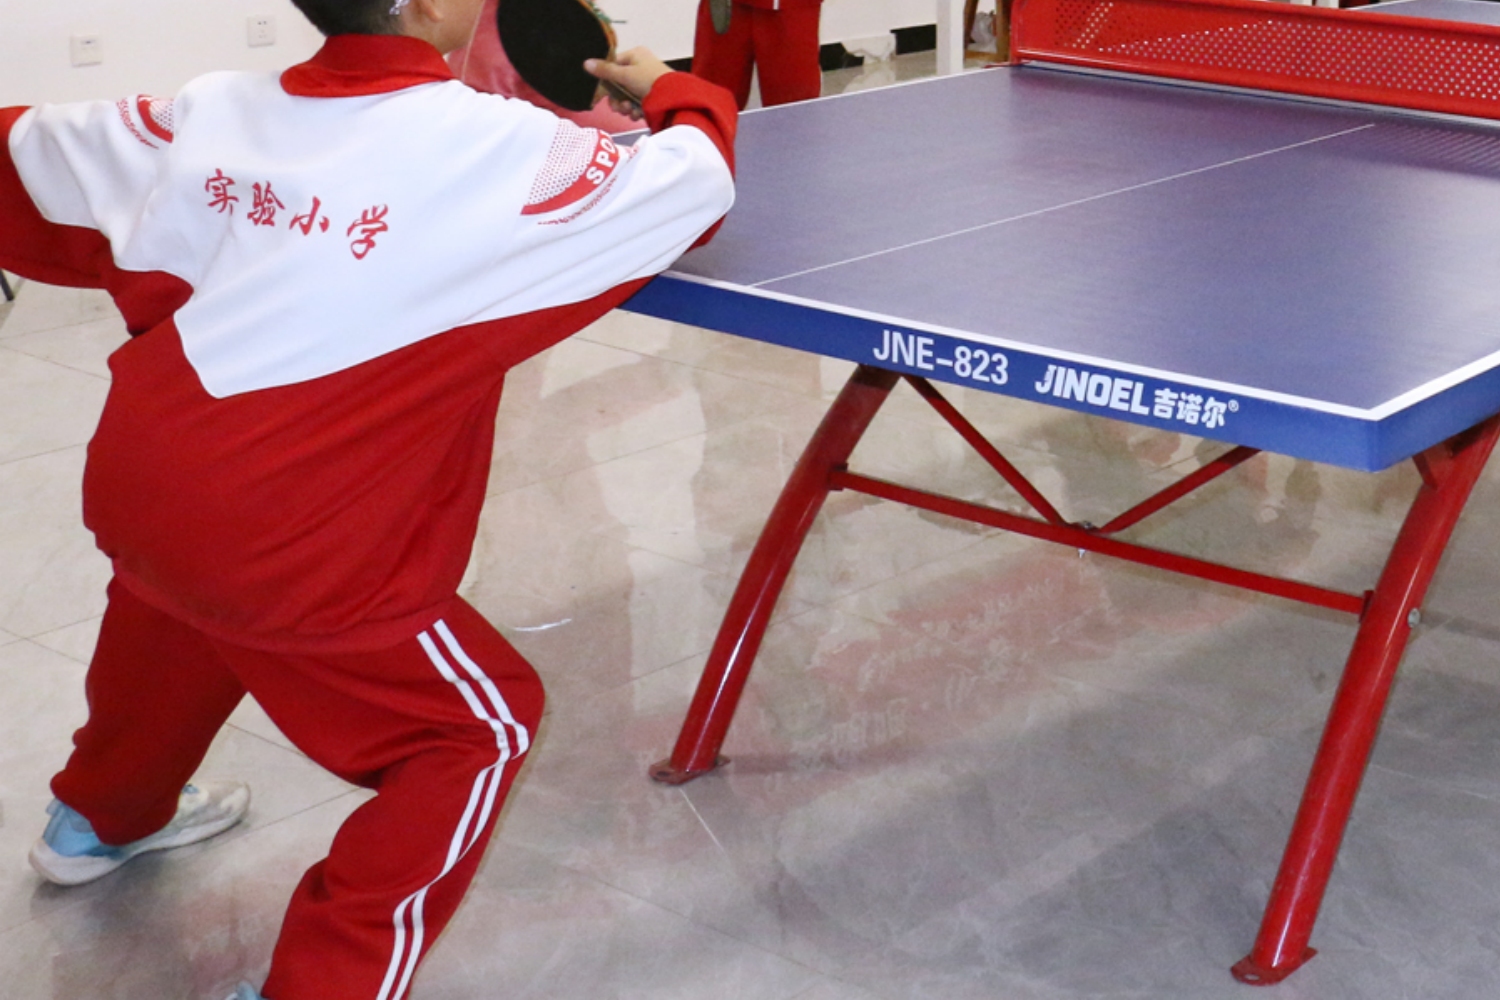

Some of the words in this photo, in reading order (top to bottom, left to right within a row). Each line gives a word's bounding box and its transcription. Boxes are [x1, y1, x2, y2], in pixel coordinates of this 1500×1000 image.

[204, 167, 389, 261] 实验小学
[873, 329, 1009, 385] JNE-823
[1034, 363, 1150, 416] JINOEL
